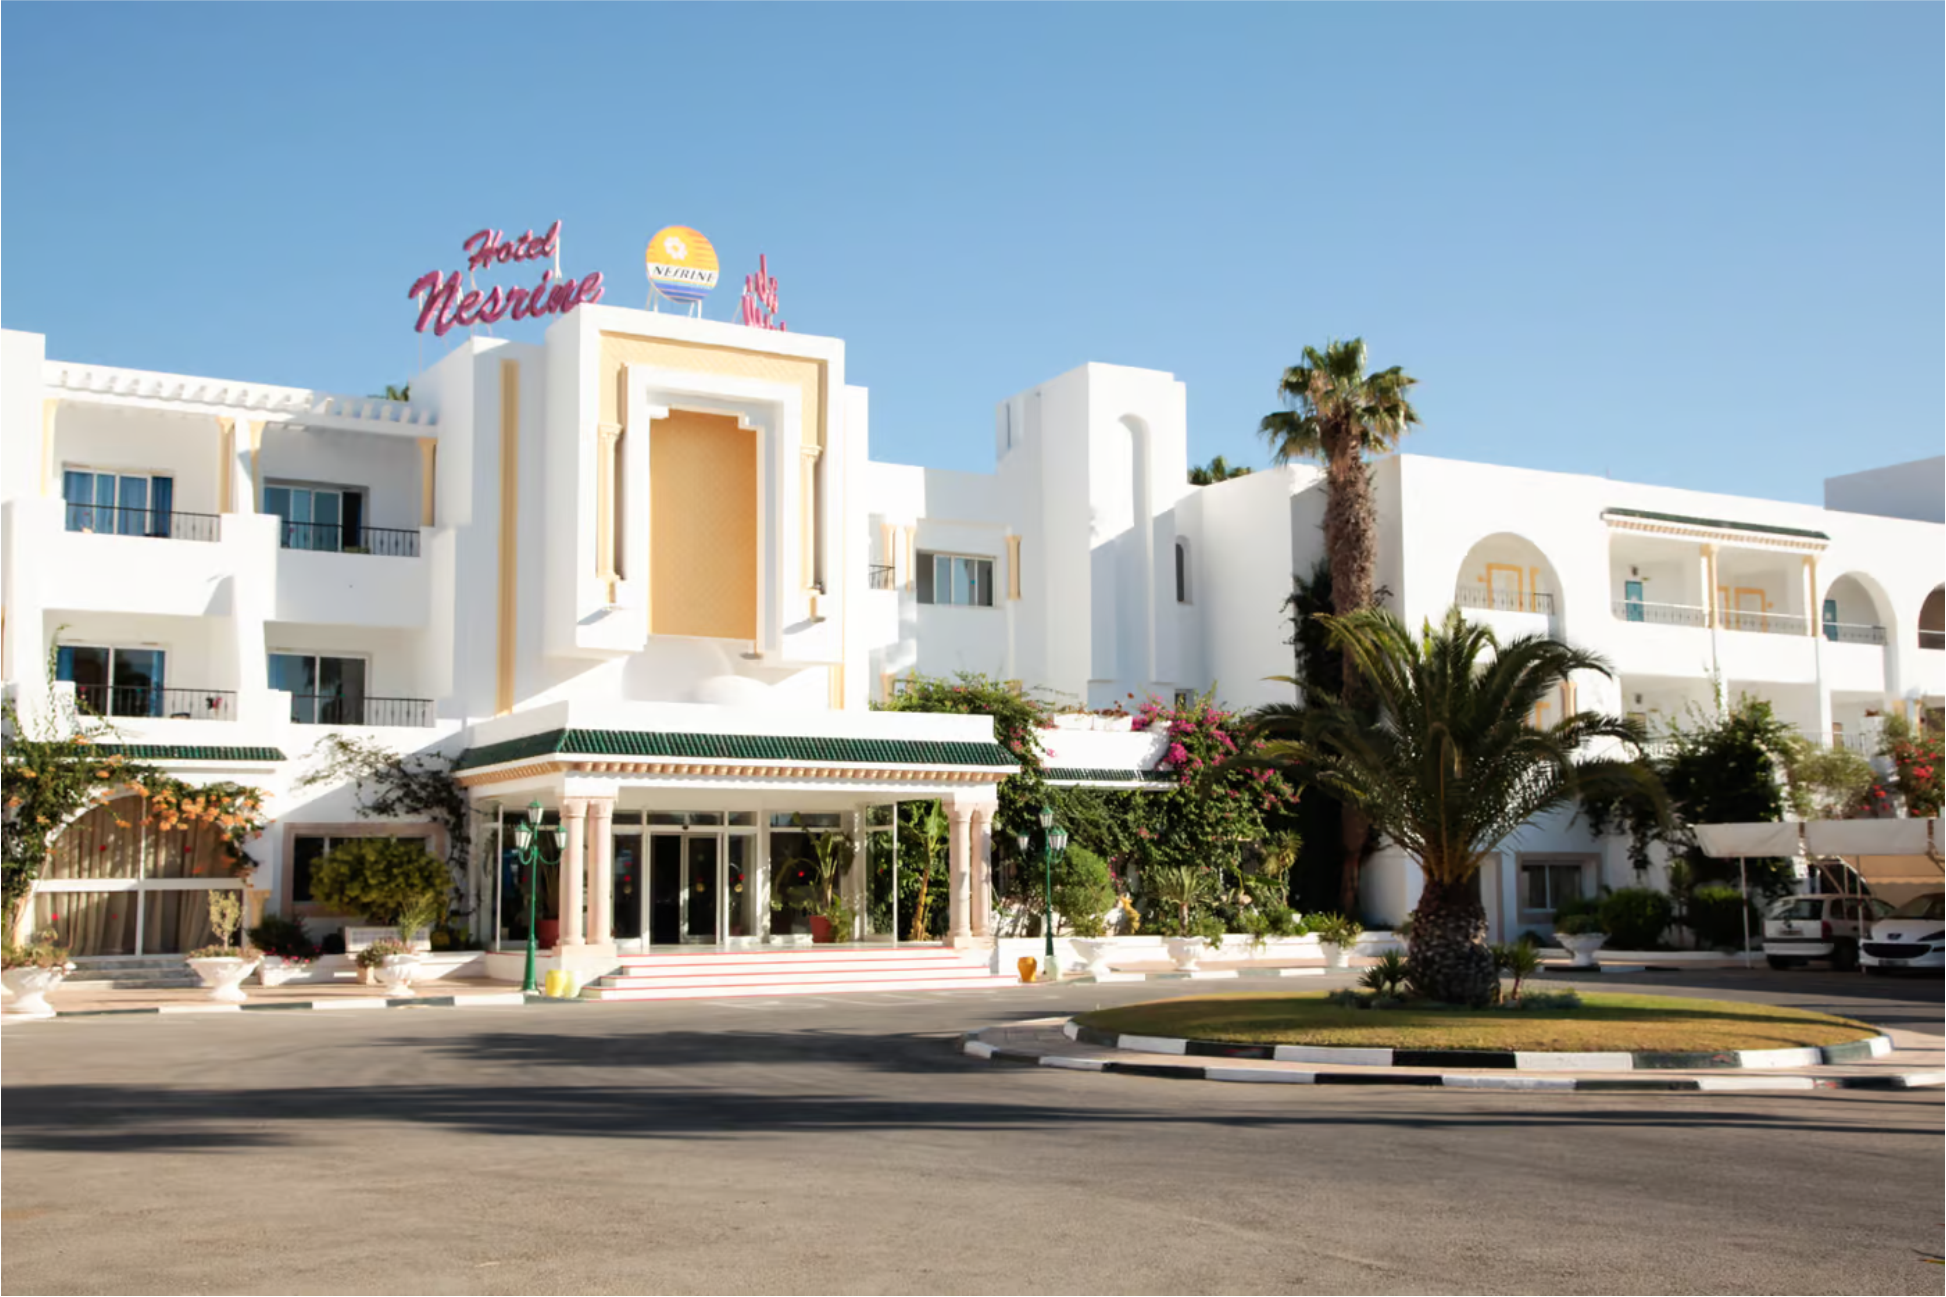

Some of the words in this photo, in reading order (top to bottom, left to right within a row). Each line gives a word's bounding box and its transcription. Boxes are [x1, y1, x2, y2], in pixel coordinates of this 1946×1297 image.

[463, 219, 562, 270] Hotel
[653, 265, 716, 283] NESRINE
[408, 269, 605, 337] Nesrine
